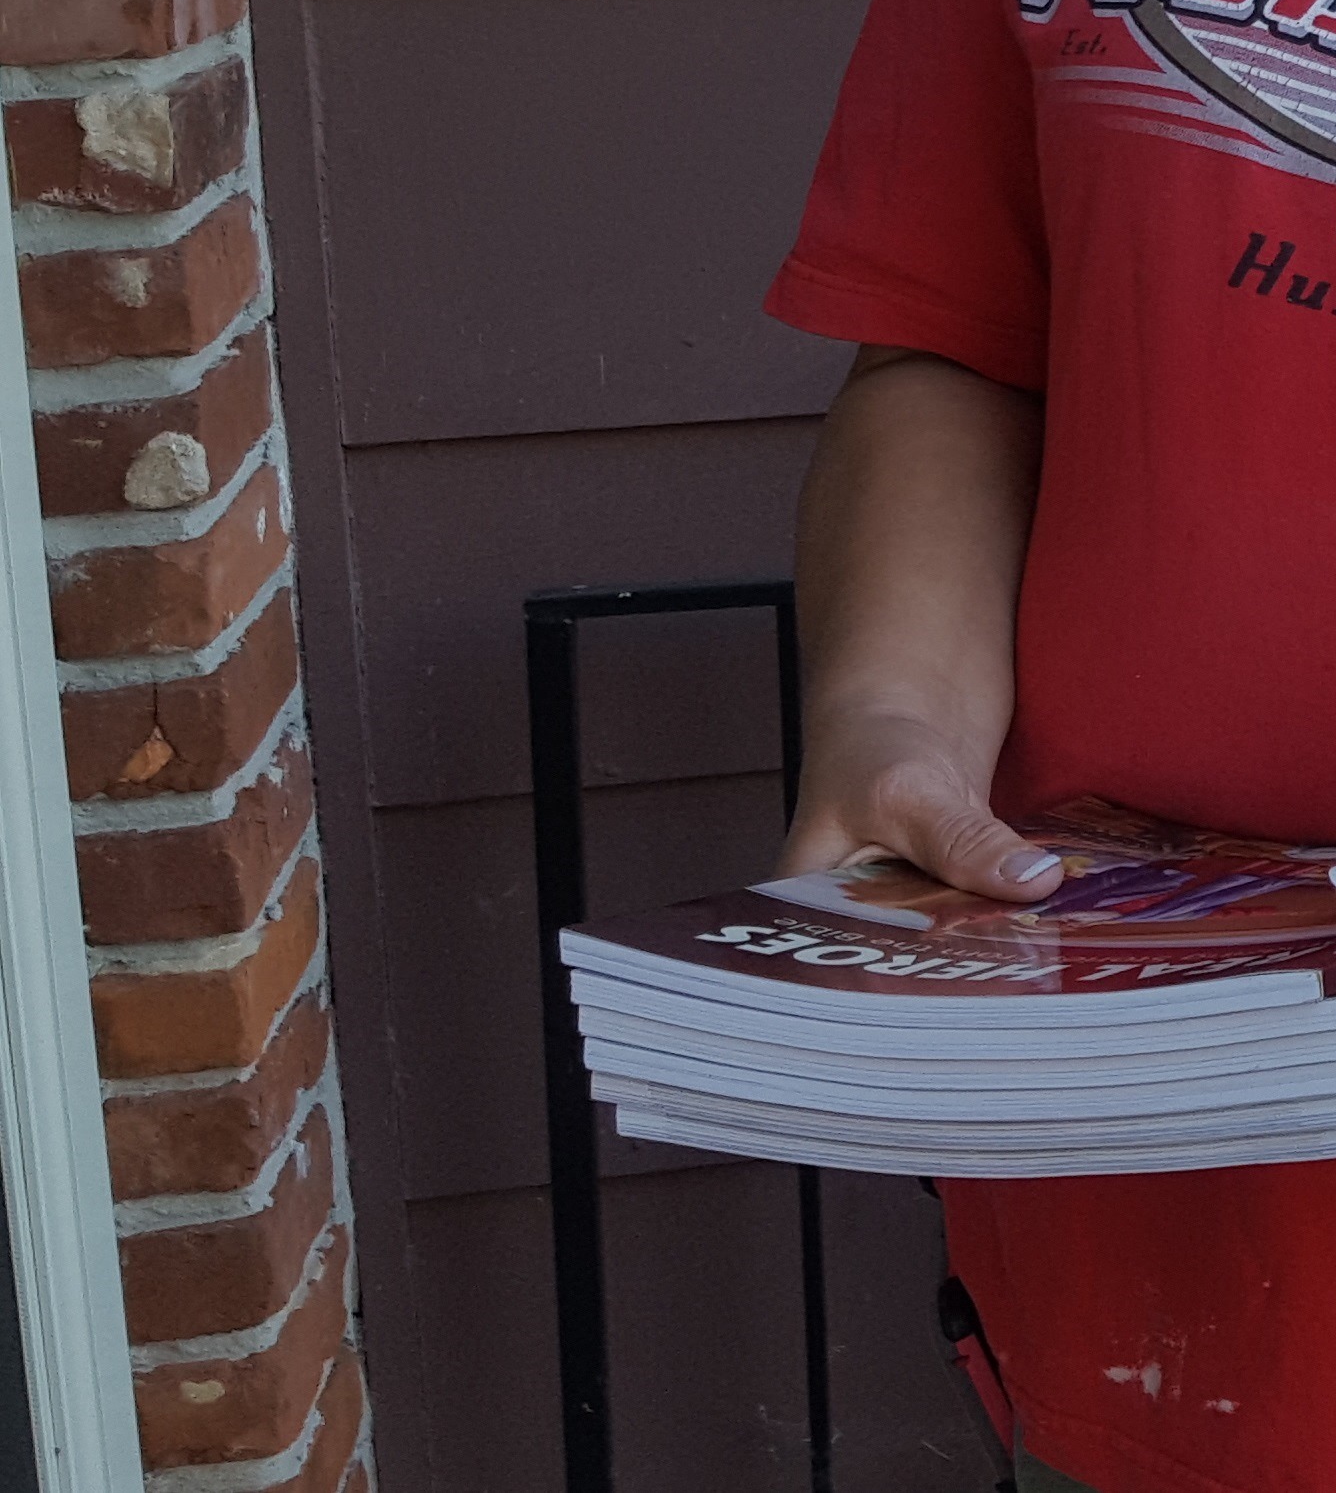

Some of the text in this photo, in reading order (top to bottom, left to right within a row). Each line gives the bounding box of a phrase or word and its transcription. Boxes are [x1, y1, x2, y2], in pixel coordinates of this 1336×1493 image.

[1062, 28, 1106, 56] Est.
[773, 916, 866, 943] Bible
[694, 925, 1072, 982] HEROES
